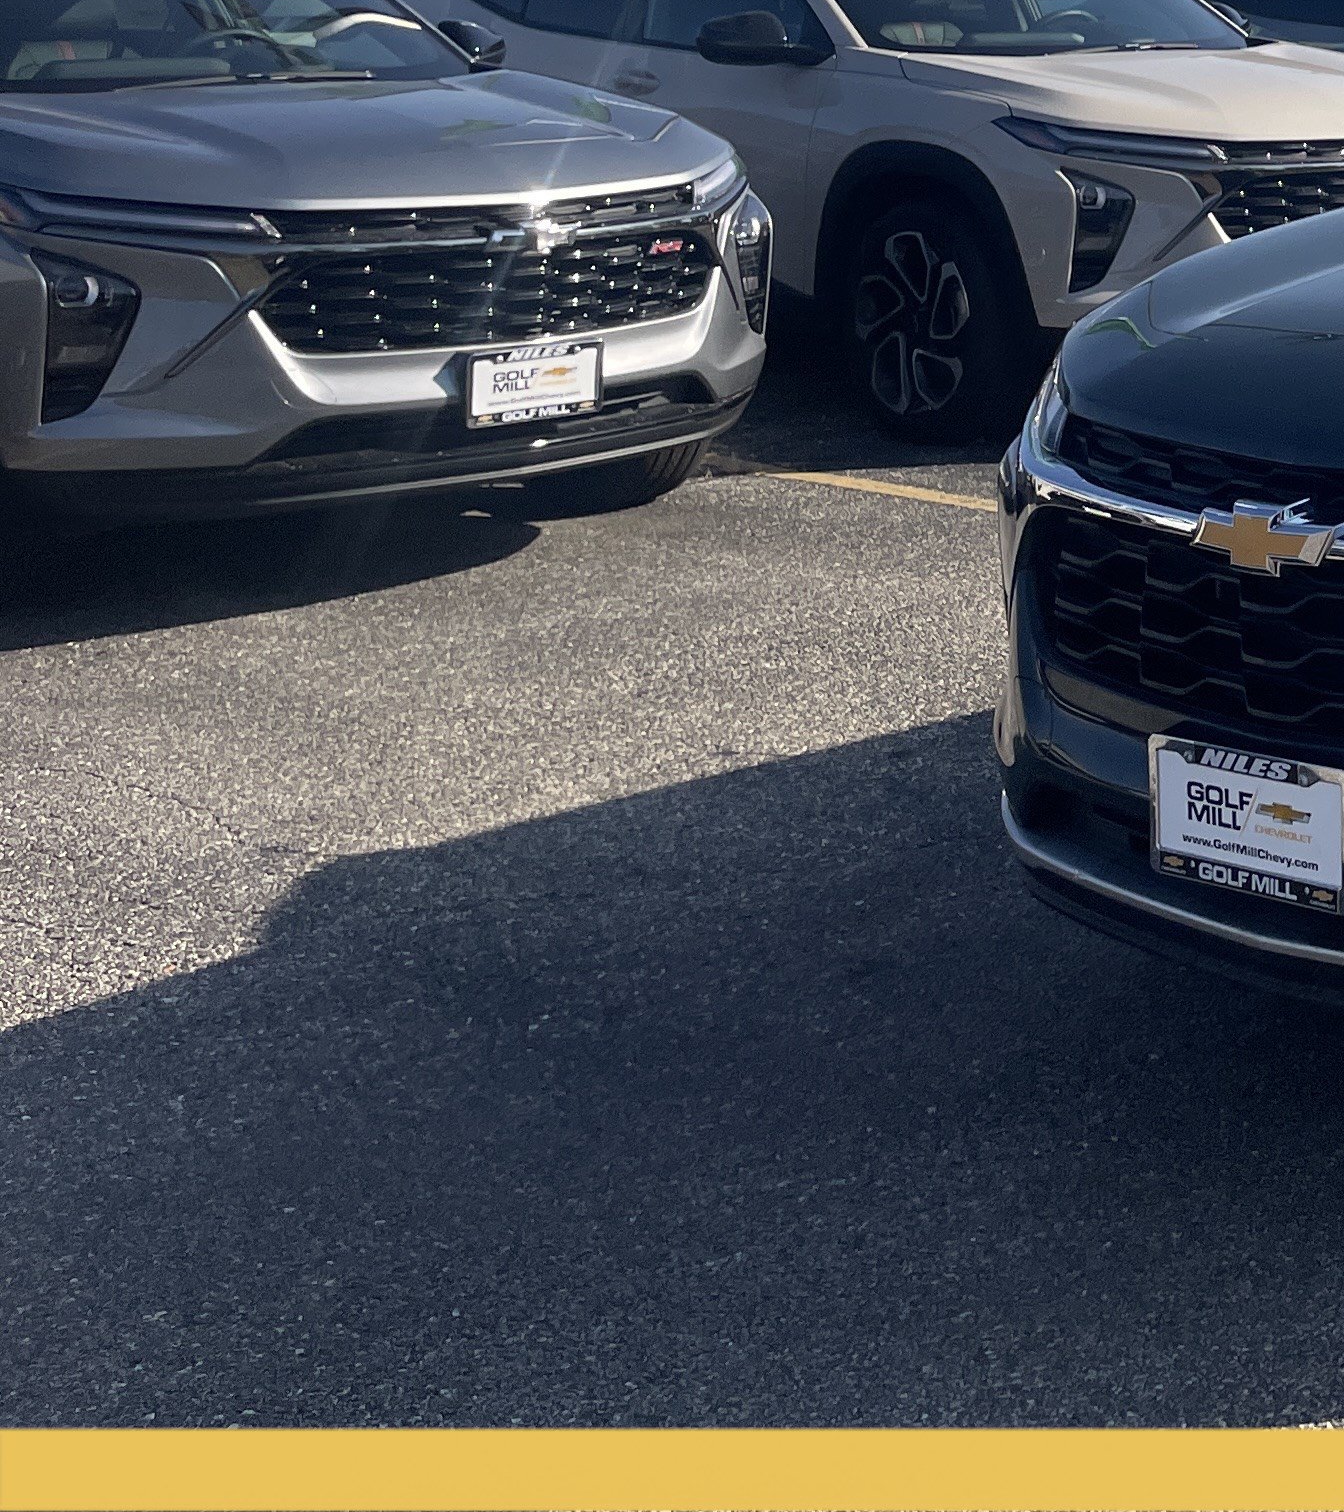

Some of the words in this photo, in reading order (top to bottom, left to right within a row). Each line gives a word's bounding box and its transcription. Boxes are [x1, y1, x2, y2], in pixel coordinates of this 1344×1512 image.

[492, 379, 531, 394] MILL
[493, 368, 540, 384] GOLF
[501, 407, 537, 423] GOLF
[538, 404, 571, 418] MILL
[1200, 748, 1293, 781] NILES
[1186, 780, 1254, 813] GOLF
[1186, 800, 1242, 831] MILL
[1181, 832, 1320, 872] www.GolfMillChevy.com
[1197, 861, 1251, 889] GOLF
[1250, 872, 1298, 902] MILL
